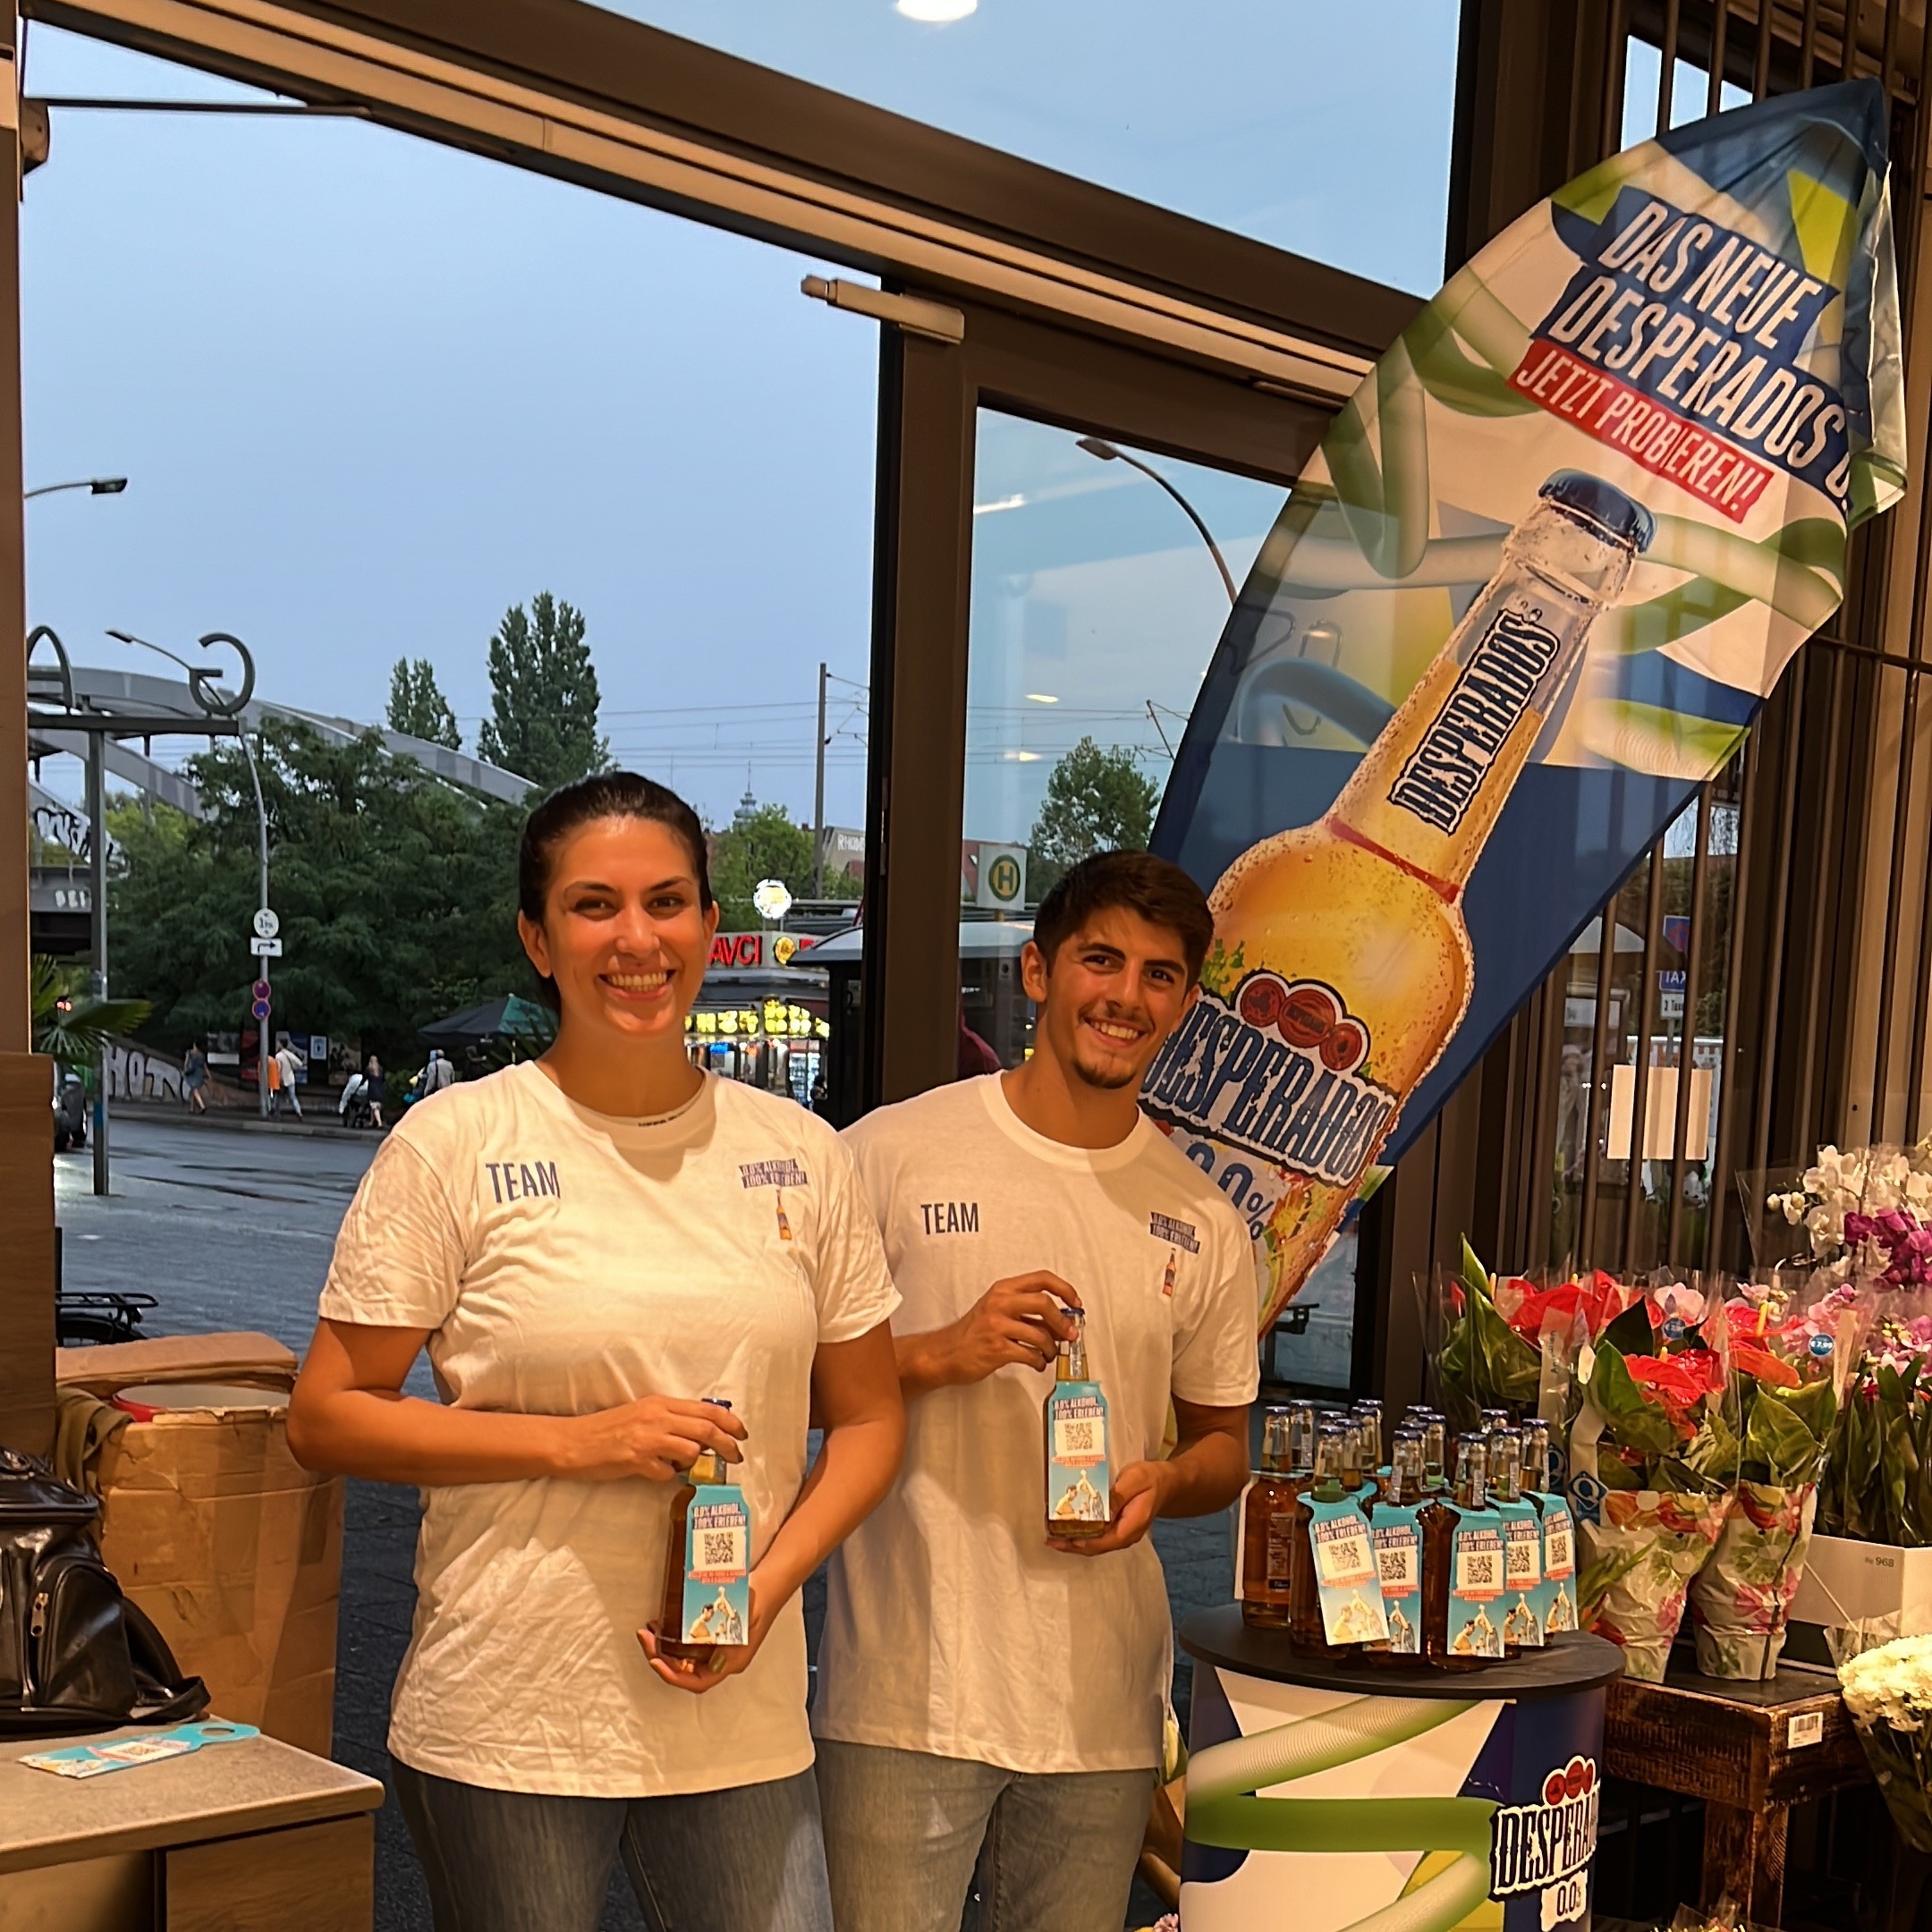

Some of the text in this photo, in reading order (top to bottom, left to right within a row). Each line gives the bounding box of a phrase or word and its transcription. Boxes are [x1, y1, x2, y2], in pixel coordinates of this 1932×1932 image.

[1598, 200, 1822, 349] DAS NEUE
[1548, 275, 1845, 470] DESPERADOS
[1517, 350, 1765, 512] JETZT PROBIEREN!
[1393, 614, 1557, 829] DESPERADOS
[998, 865, 1013, 891] H
[708, 936, 762, 966] AVCI
[1140, 1001, 1393, 1181] DESPERADOS
[486, 1160, 561, 1204] TEAM
[920, 1202, 979, 1235] TEAM
[1572, 1477, 1599, 1504] Q
[1374, 1538, 1388, 1549] 00%
[1876, 1556, 1894, 1567] 968
